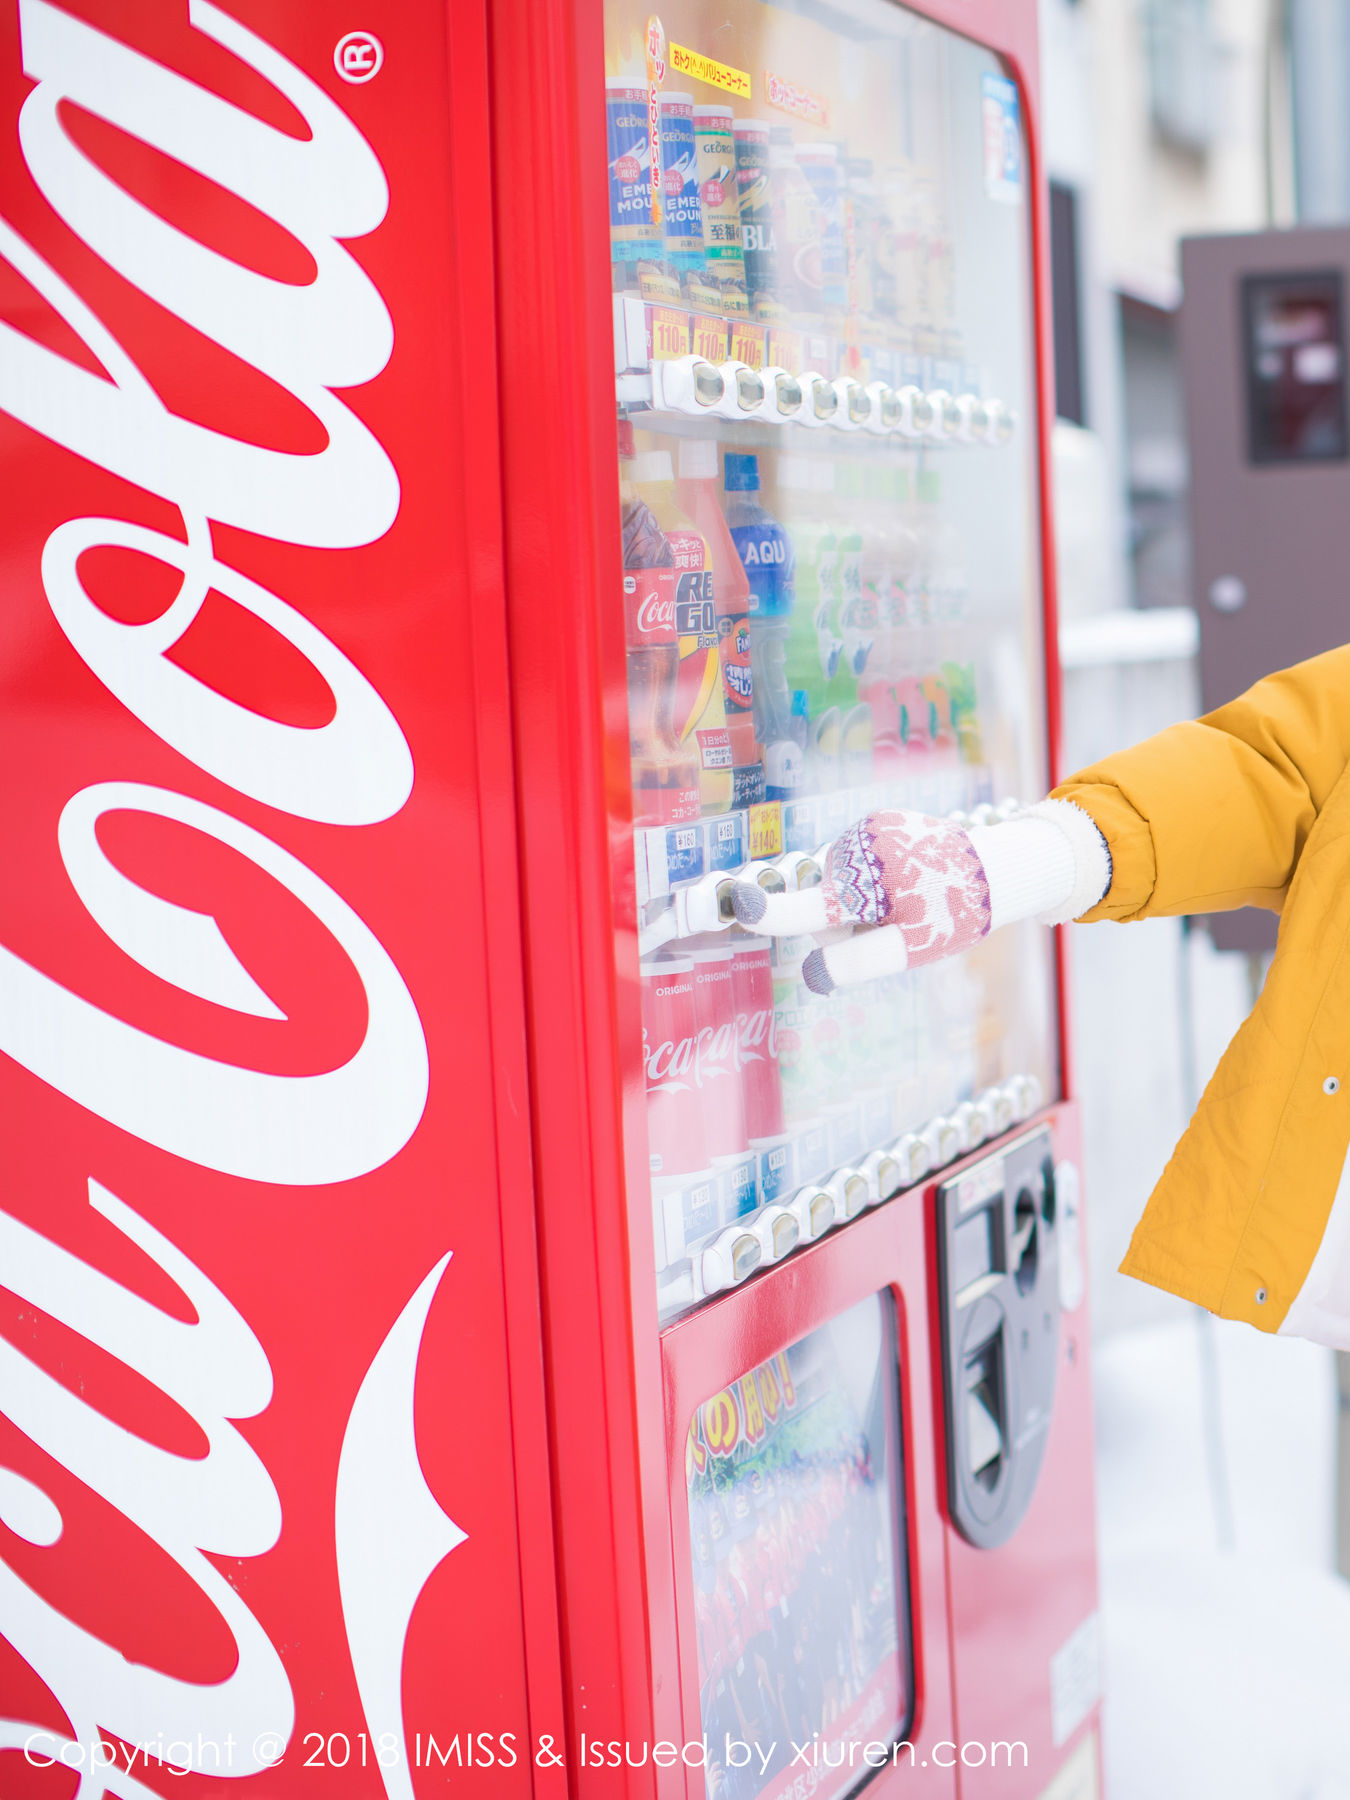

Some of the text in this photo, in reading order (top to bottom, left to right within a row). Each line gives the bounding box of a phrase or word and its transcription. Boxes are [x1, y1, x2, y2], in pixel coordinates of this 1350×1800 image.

[741, 225, 776, 251] BLA
[744, 541, 786, 565] AQU
[676, 571, 713, 603] RE
[674, 601, 715, 635] GO
